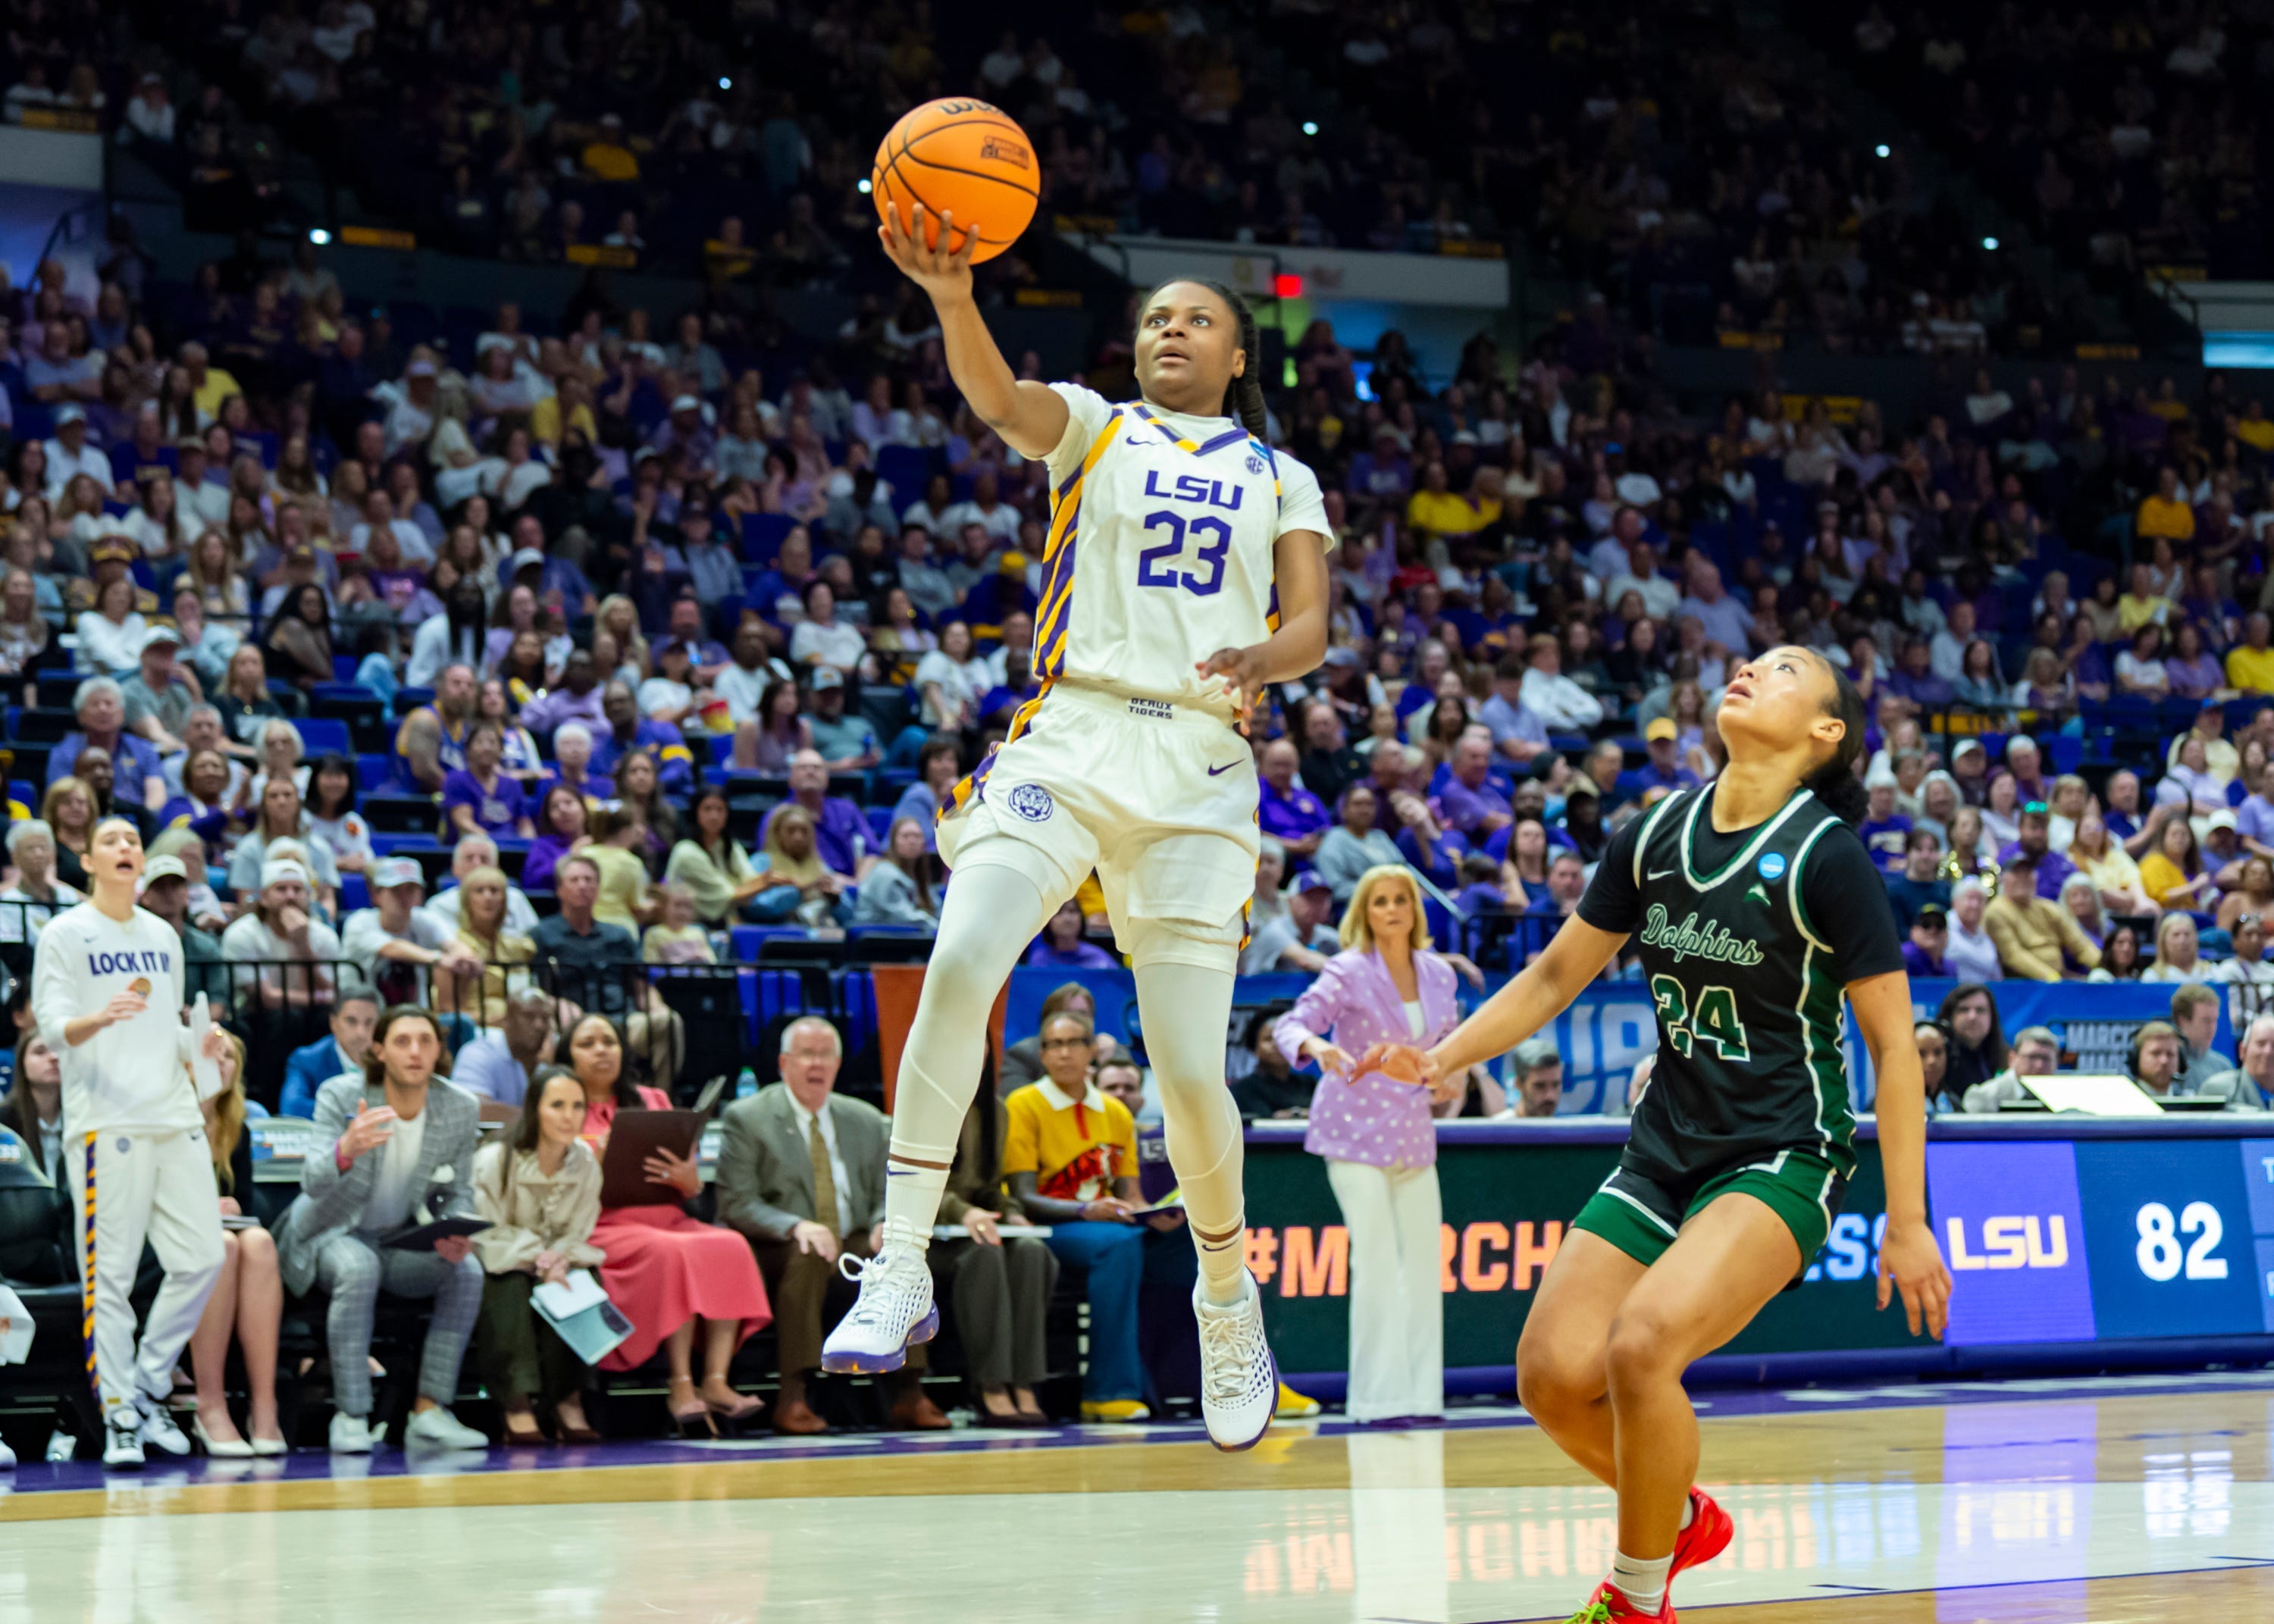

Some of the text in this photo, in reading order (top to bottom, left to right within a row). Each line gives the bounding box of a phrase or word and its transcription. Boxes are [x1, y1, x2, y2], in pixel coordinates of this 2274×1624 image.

[1145, 470, 1244, 511] LSU
[1138, 510, 1233, 596] 23
[1128, 706, 1173, 719] TIGERS
[88, 952, 139, 975] LOCK
[140, 951, 157, 972] IT
[1640, 903, 1765, 965] Dolphins
[1651, 973, 1751, 1062] 24
[1946, 1215, 2069, 1271] LSU
[2135, 1200, 2229, 1282] 82
